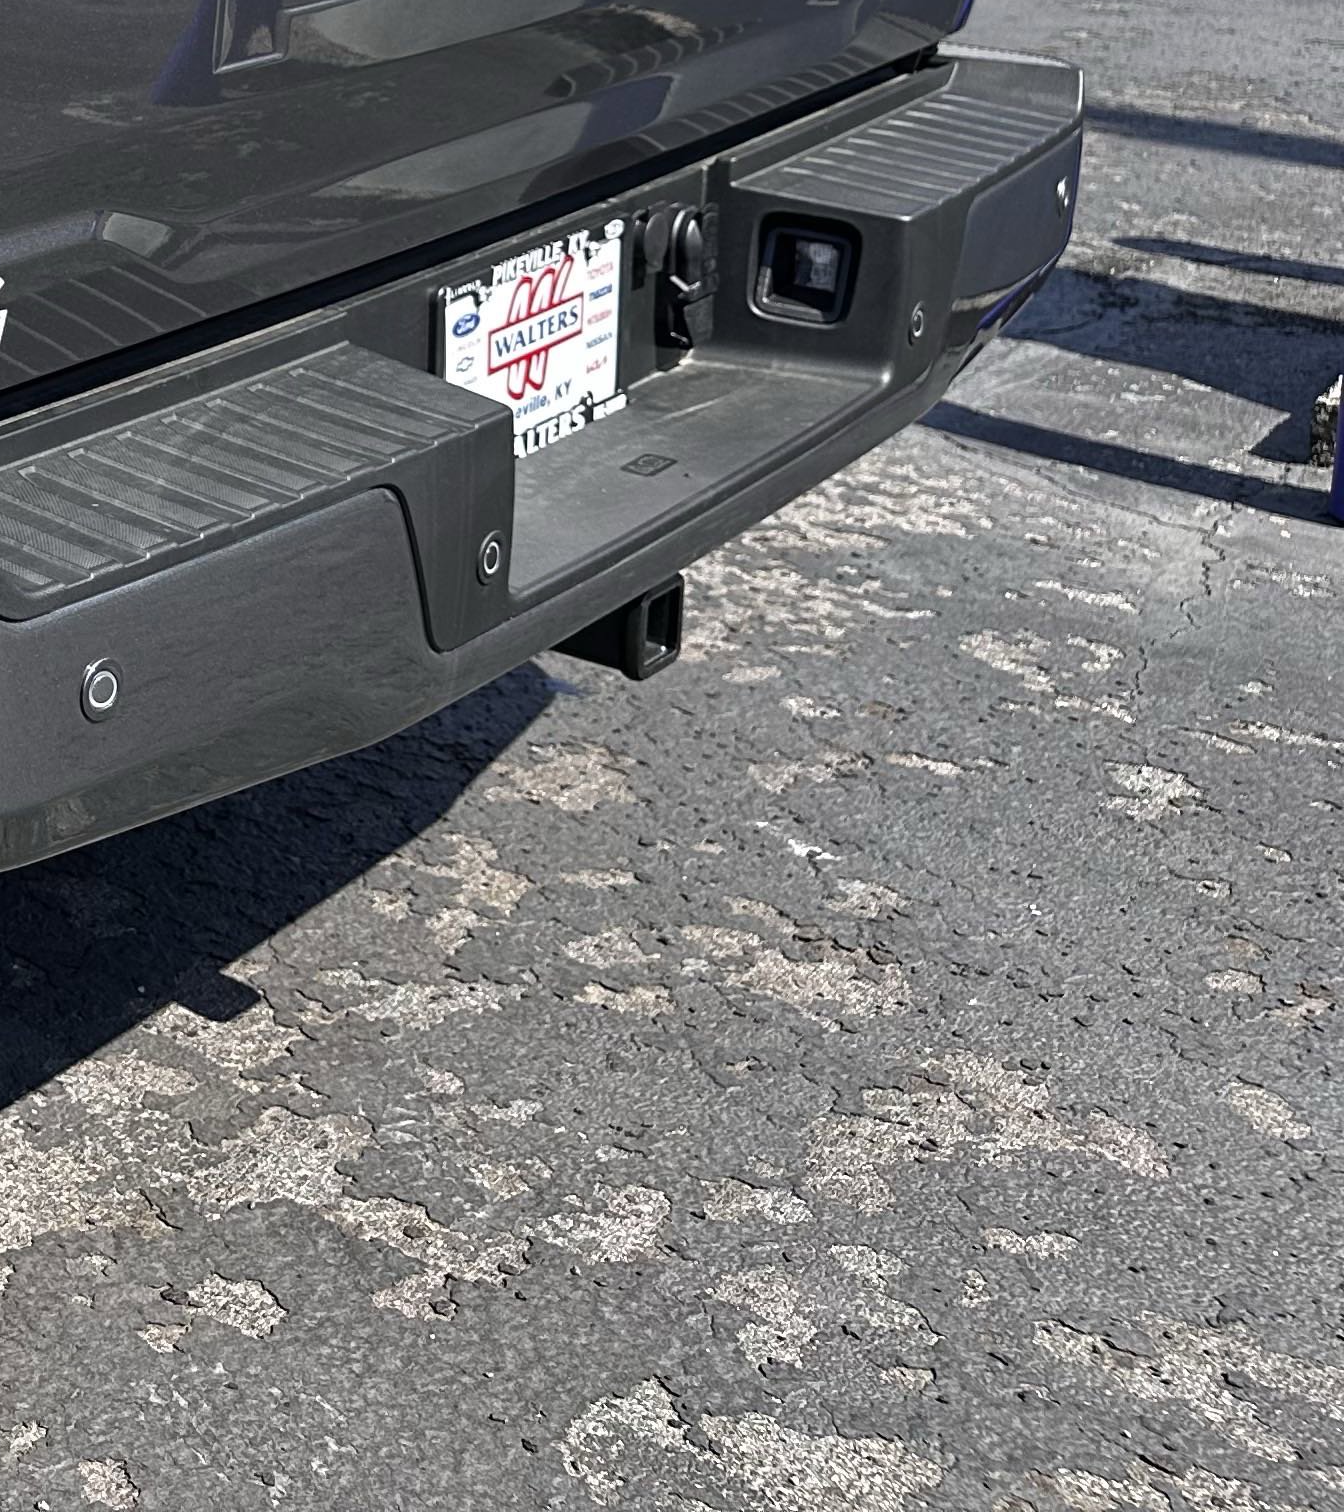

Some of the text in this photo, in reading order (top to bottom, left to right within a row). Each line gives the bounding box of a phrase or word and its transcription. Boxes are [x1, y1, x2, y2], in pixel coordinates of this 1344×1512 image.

[491, 229, 590, 287] PIKEVILLE KY
[494, 305, 579, 358] WALTERS
[514, 378, 572, 419] eville, KY
[513, 403, 587, 459] ALTERS
